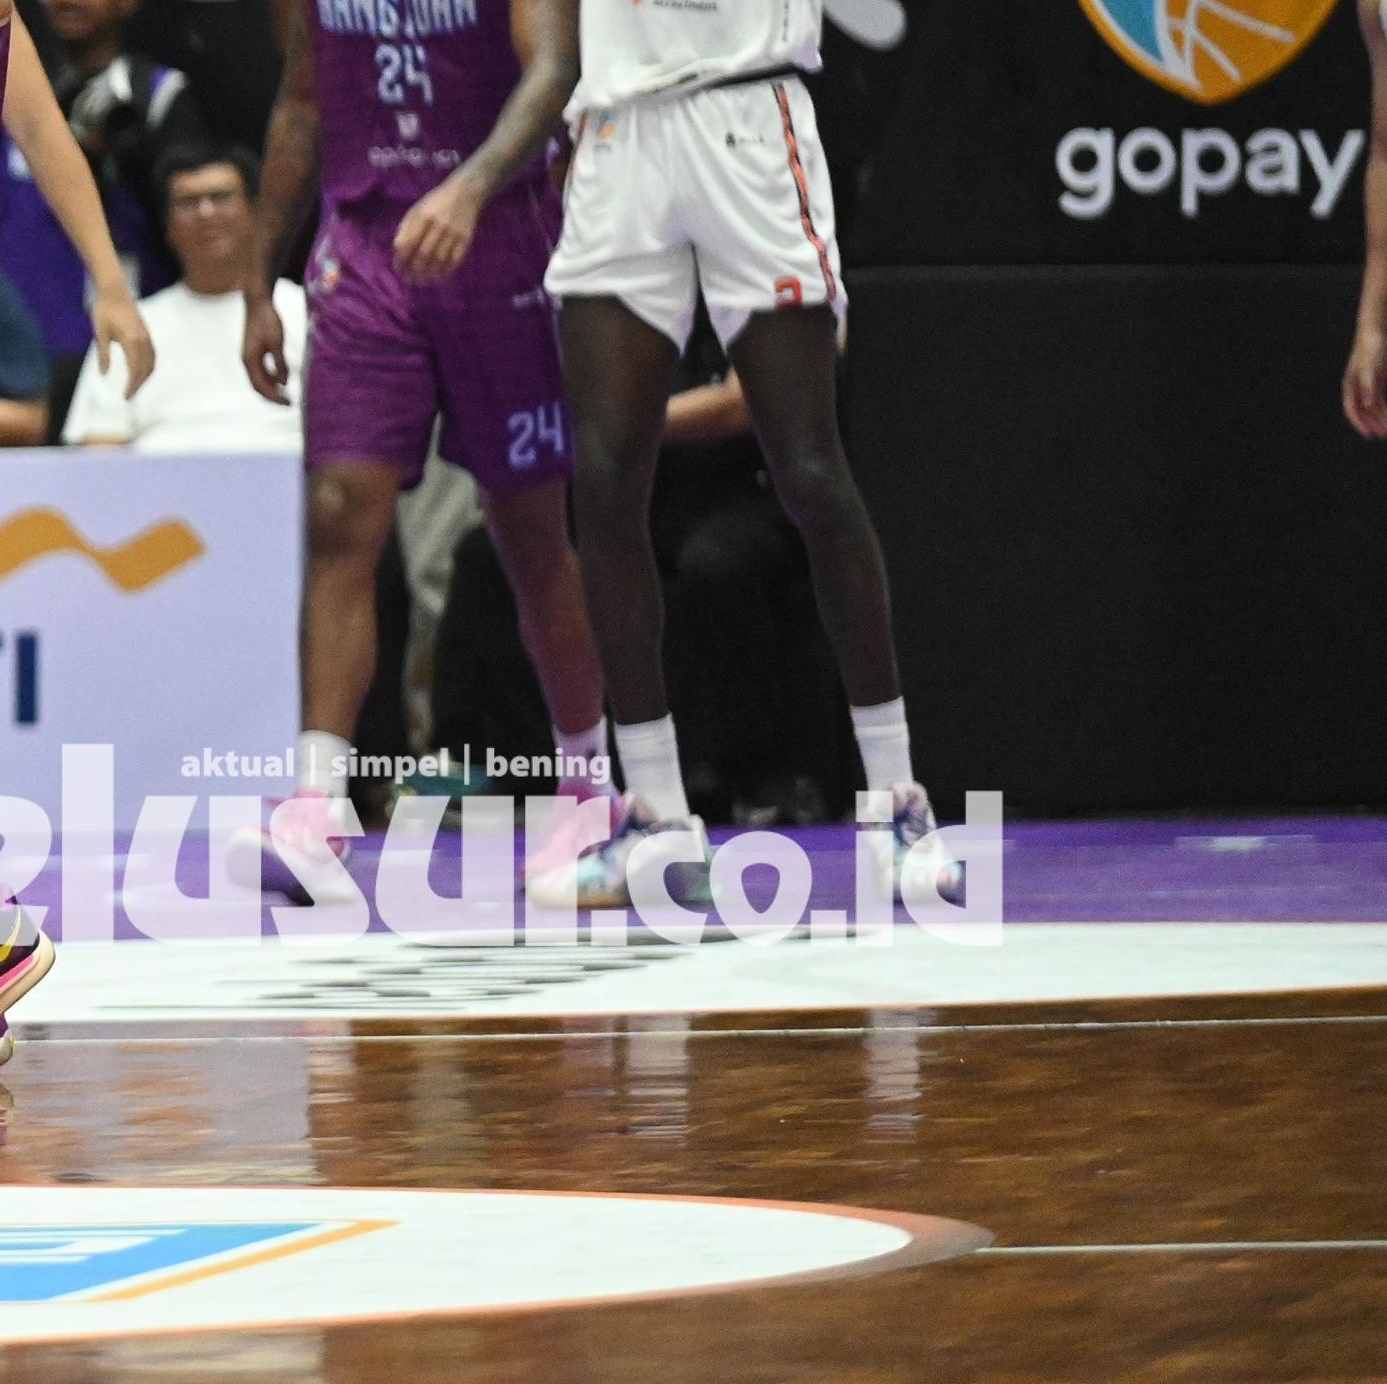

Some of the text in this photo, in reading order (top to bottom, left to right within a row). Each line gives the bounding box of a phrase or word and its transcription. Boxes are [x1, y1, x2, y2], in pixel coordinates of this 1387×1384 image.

[375, 43, 434, 107] 24
[1055, 126, 1365, 220] gopay
[507, 401, 565, 468] 24
